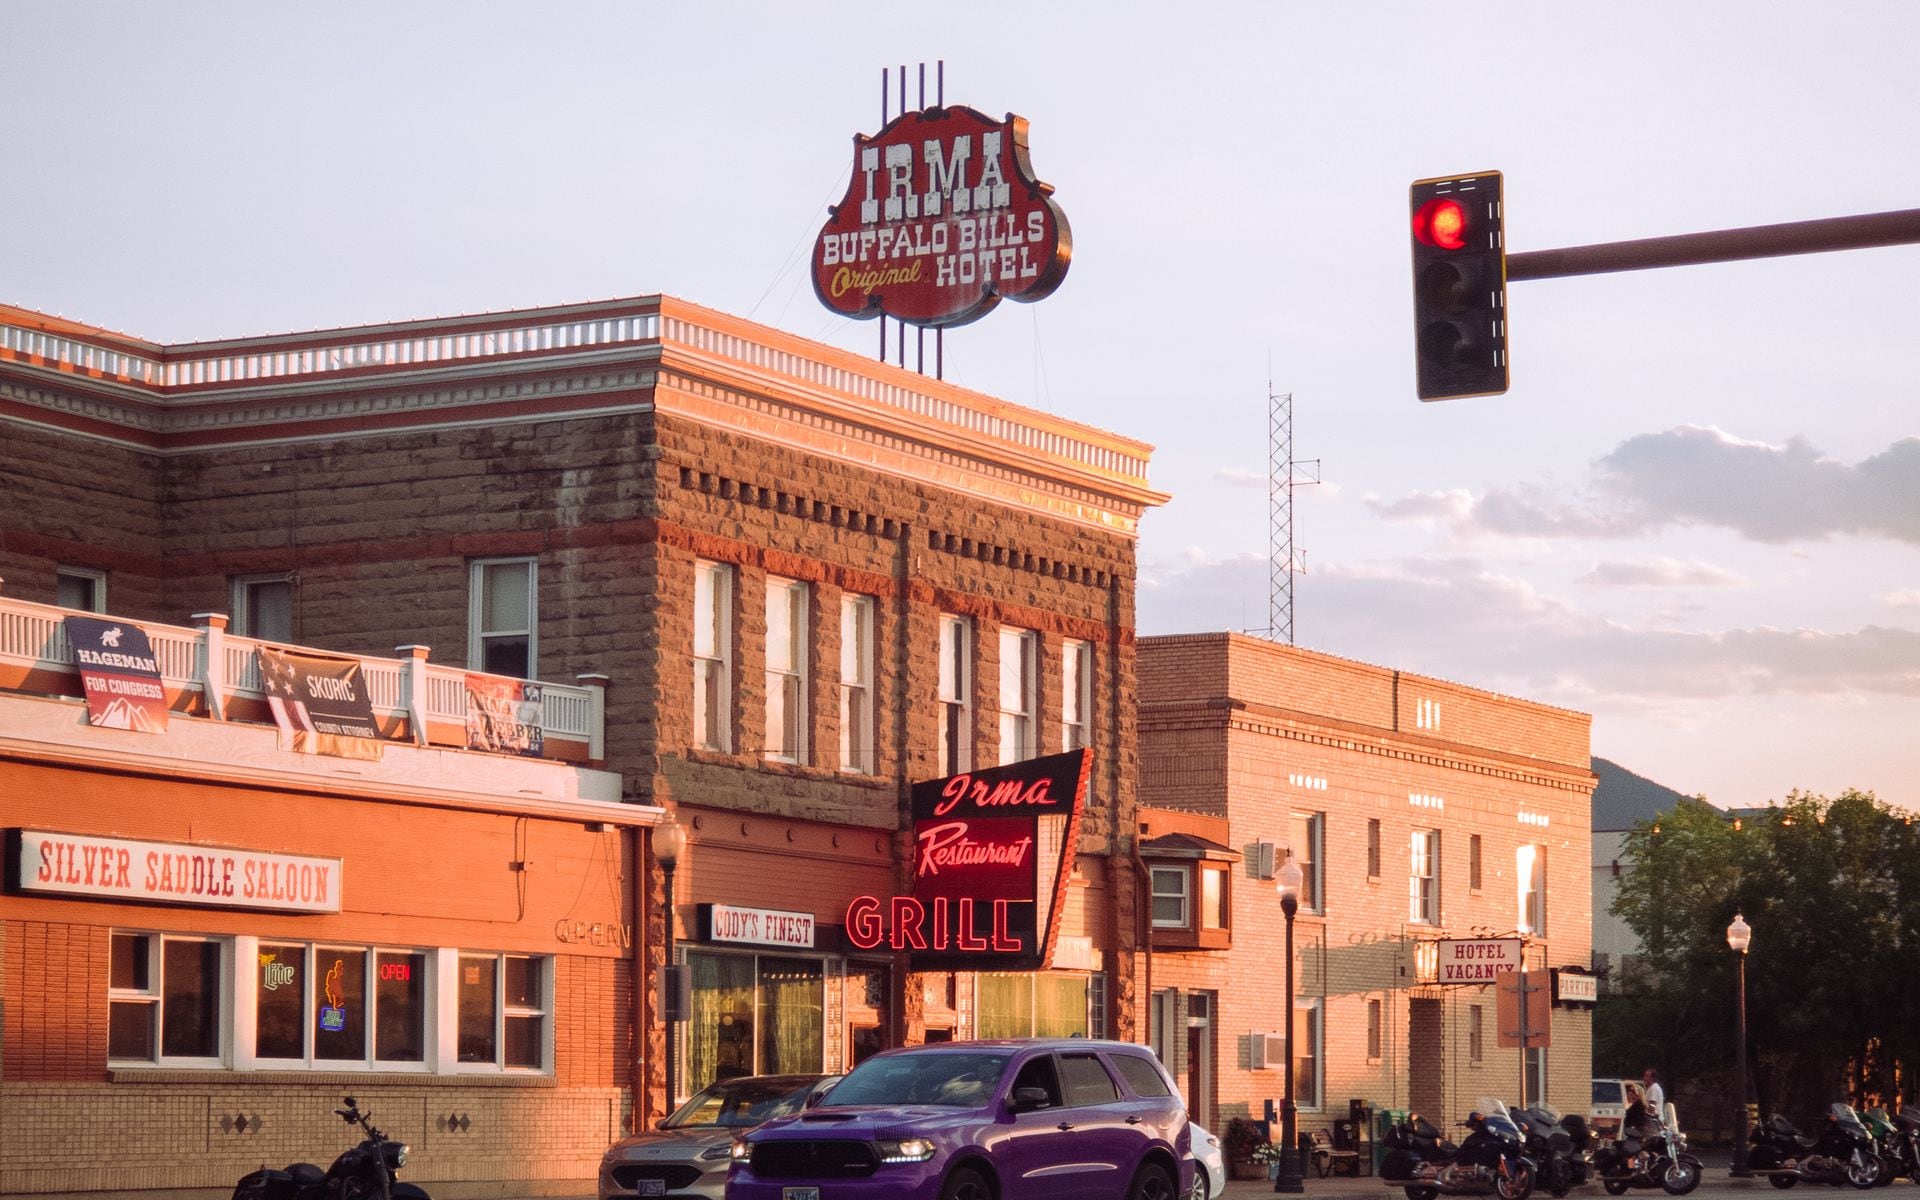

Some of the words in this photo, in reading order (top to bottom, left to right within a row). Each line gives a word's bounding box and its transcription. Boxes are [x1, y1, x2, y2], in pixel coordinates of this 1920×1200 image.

[861, 131, 1010, 224] IRMA
[823, 222, 948, 265] BUFFALO
[959, 211, 1044, 251] BILLS
[831, 259, 922, 297] Original
[936, 247, 1037, 287] HOTEL
[77, 649, 157, 672] HAGEMAN
[85, 676, 108, 692] FOR
[108, 679, 163, 699] CONGRESS
[307, 675, 355, 702] SKORIC
[934, 774, 1057, 816] Irma
[918, 821, 1032, 878] Restaurant
[38, 840, 131, 888] SILVER
[145, 850, 235, 897] SADDLE
[243, 859, 330, 903] SALOON
[715, 910, 759, 938] CODY'S
[765, 914, 811, 944] FINEST
[846, 895, 1022, 952] GRILL
[1454, 944, 1505, 959] HOTEL
[263, 963, 295, 991] Lite
[380, 964, 411, 981] OPEN
[1559, 978, 1595, 996] PARKING
